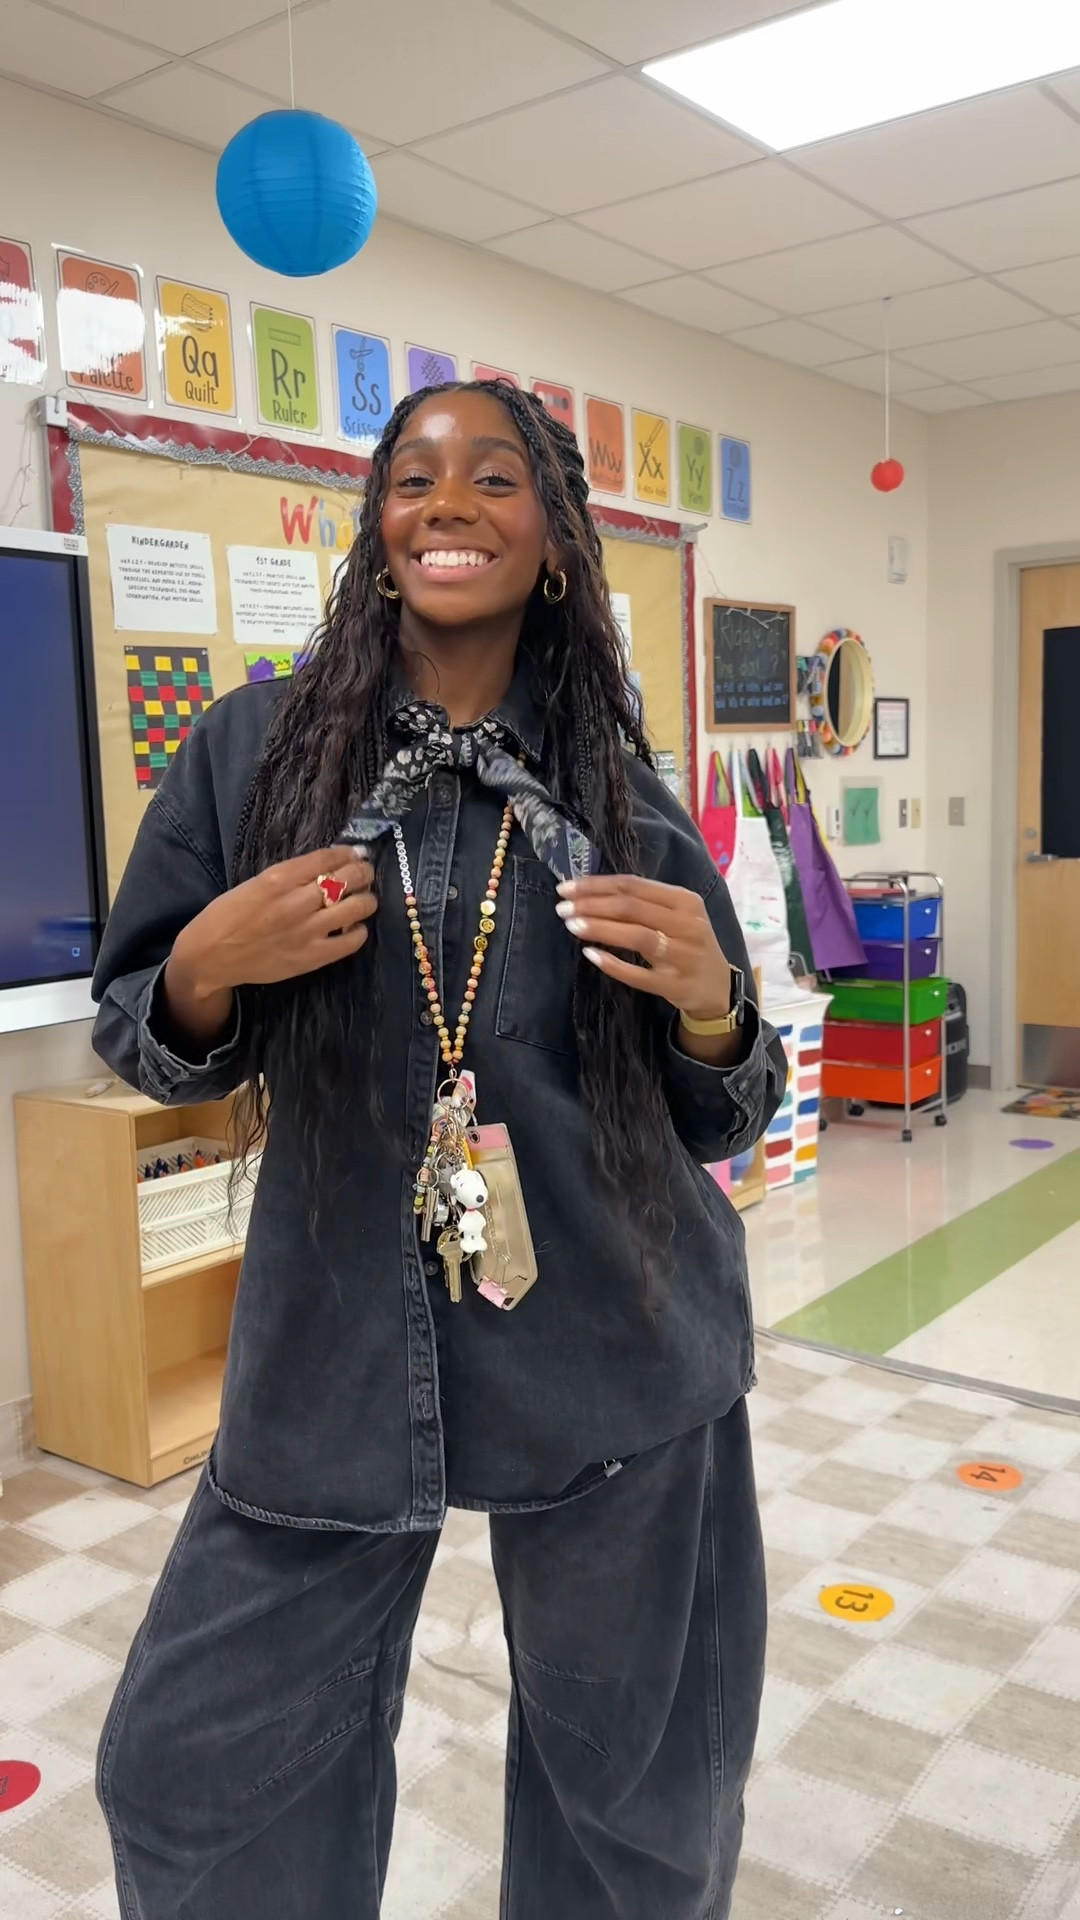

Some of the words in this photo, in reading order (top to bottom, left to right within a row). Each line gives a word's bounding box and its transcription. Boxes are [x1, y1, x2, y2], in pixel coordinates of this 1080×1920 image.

[182, 336, 219, 387] Qq
[271, 349, 305, 399] Rr
[185, 381, 218, 404] Quilt
[352, 373, 382, 415] Ss
[273, 401, 307, 425] Ruler
[344, 415, 384, 436] Sciss
[589, 437, 622, 473] Ww
[638, 442, 664, 480] Xx
[686, 454, 705, 491] Yy
[131, 535, 190, 550] KINDERGARDEN
[970, 1465, 1006, 1483] 14
[833, 1589, 875, 1613] 13
